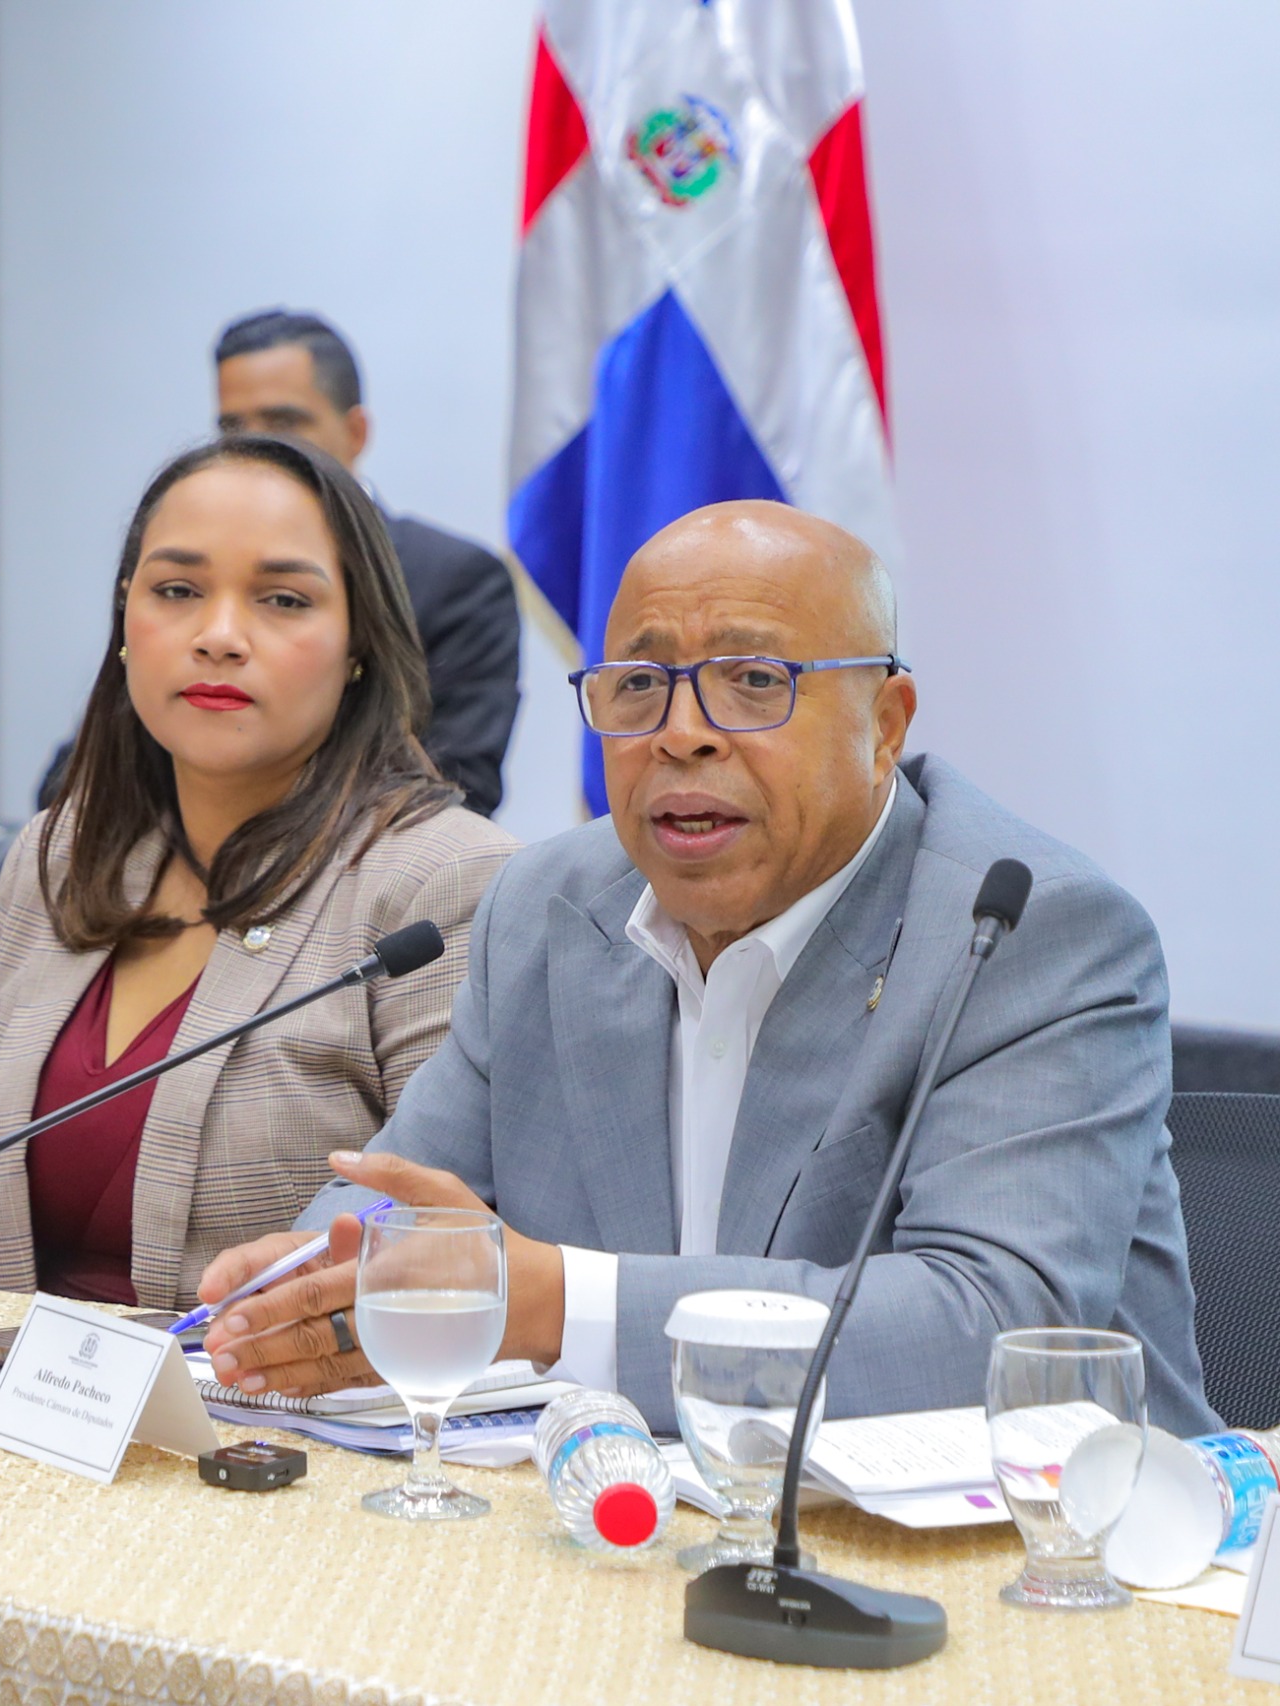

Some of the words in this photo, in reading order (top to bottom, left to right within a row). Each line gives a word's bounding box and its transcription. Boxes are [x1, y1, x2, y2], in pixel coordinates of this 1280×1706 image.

[33, 1367, 70, 1391] Alfredo
[72, 1379, 111, 1405] Pacheco
[12, 1386, 46, 1407] Presidente
[46, 1397, 71, 1416] Cámara
[72, 1407, 81, 1418] de
[81, 1410, 113, 1429] Diputados
